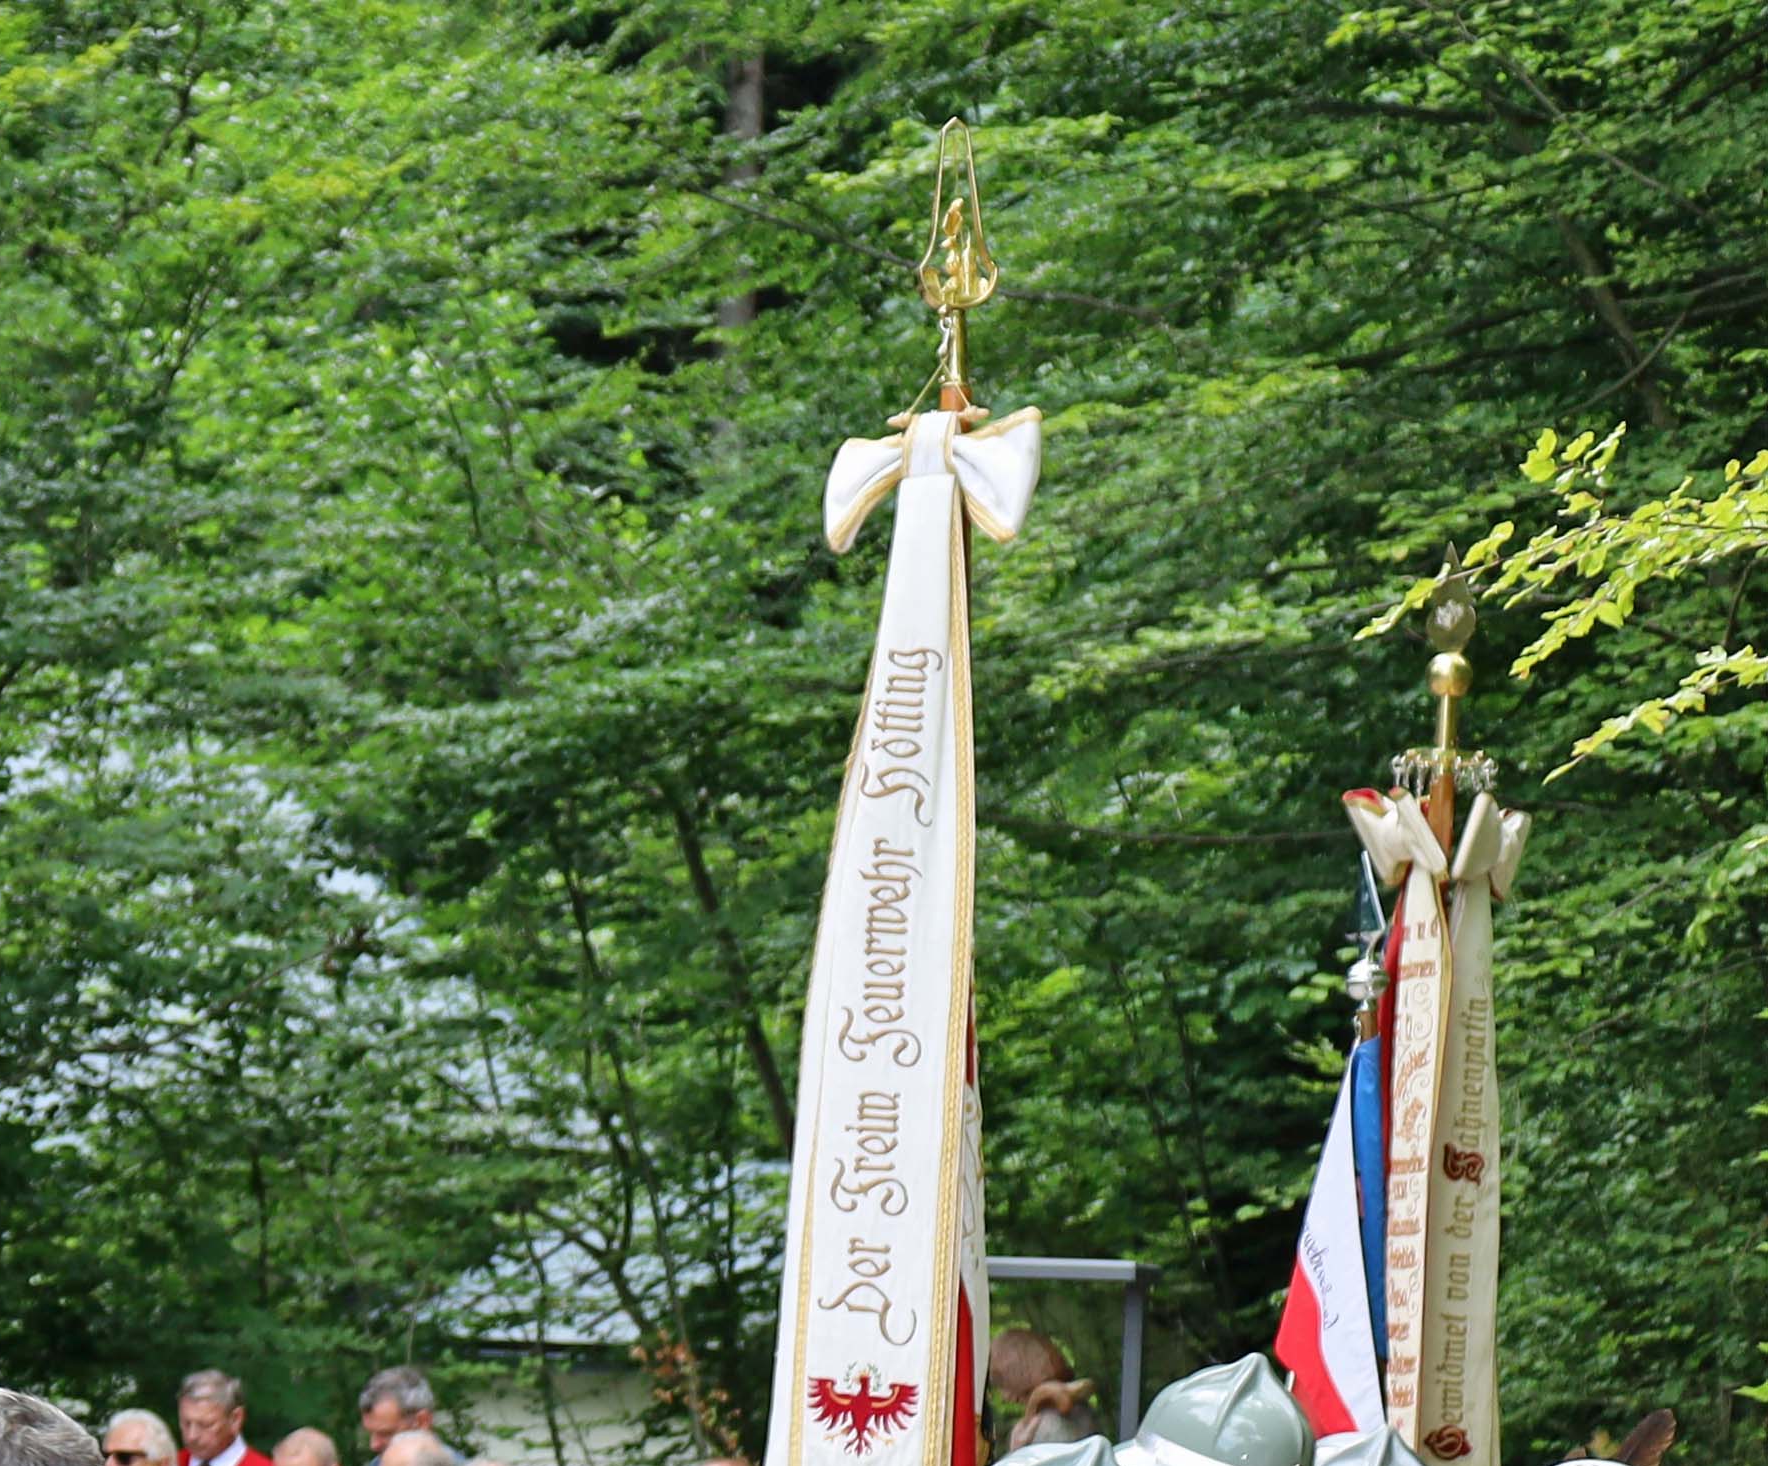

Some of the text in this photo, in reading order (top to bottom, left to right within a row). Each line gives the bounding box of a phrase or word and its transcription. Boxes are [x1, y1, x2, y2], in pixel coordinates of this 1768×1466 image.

[859, 647, 947, 828] Hötting
[838, 837, 924, 1068] Feuerwehr
[818, 1238, 917, 1345] Der
[1423, 997, 1489, 1461] Gewidmet von der Fahnenpatin
